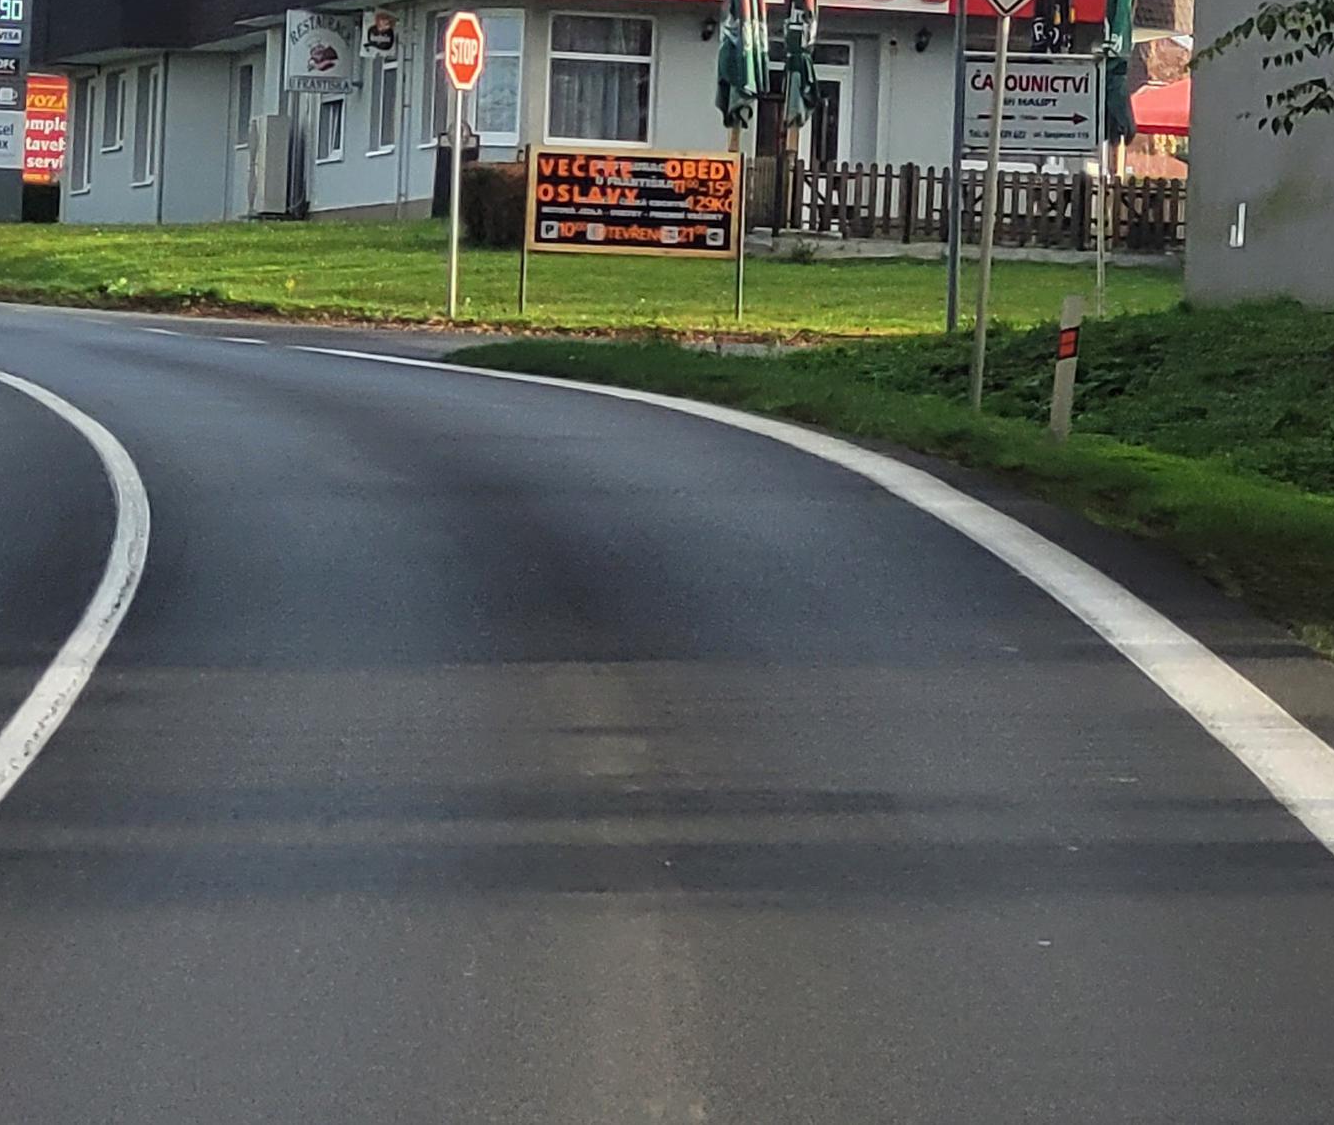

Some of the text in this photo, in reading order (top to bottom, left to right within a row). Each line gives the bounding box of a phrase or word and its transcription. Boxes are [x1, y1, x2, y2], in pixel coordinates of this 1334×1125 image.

[451, 37, 478, 66] STOP
[970, 70, 1090, 93] ČAOUNICTVÍ
[537, 183, 639, 205] OSLAVY
